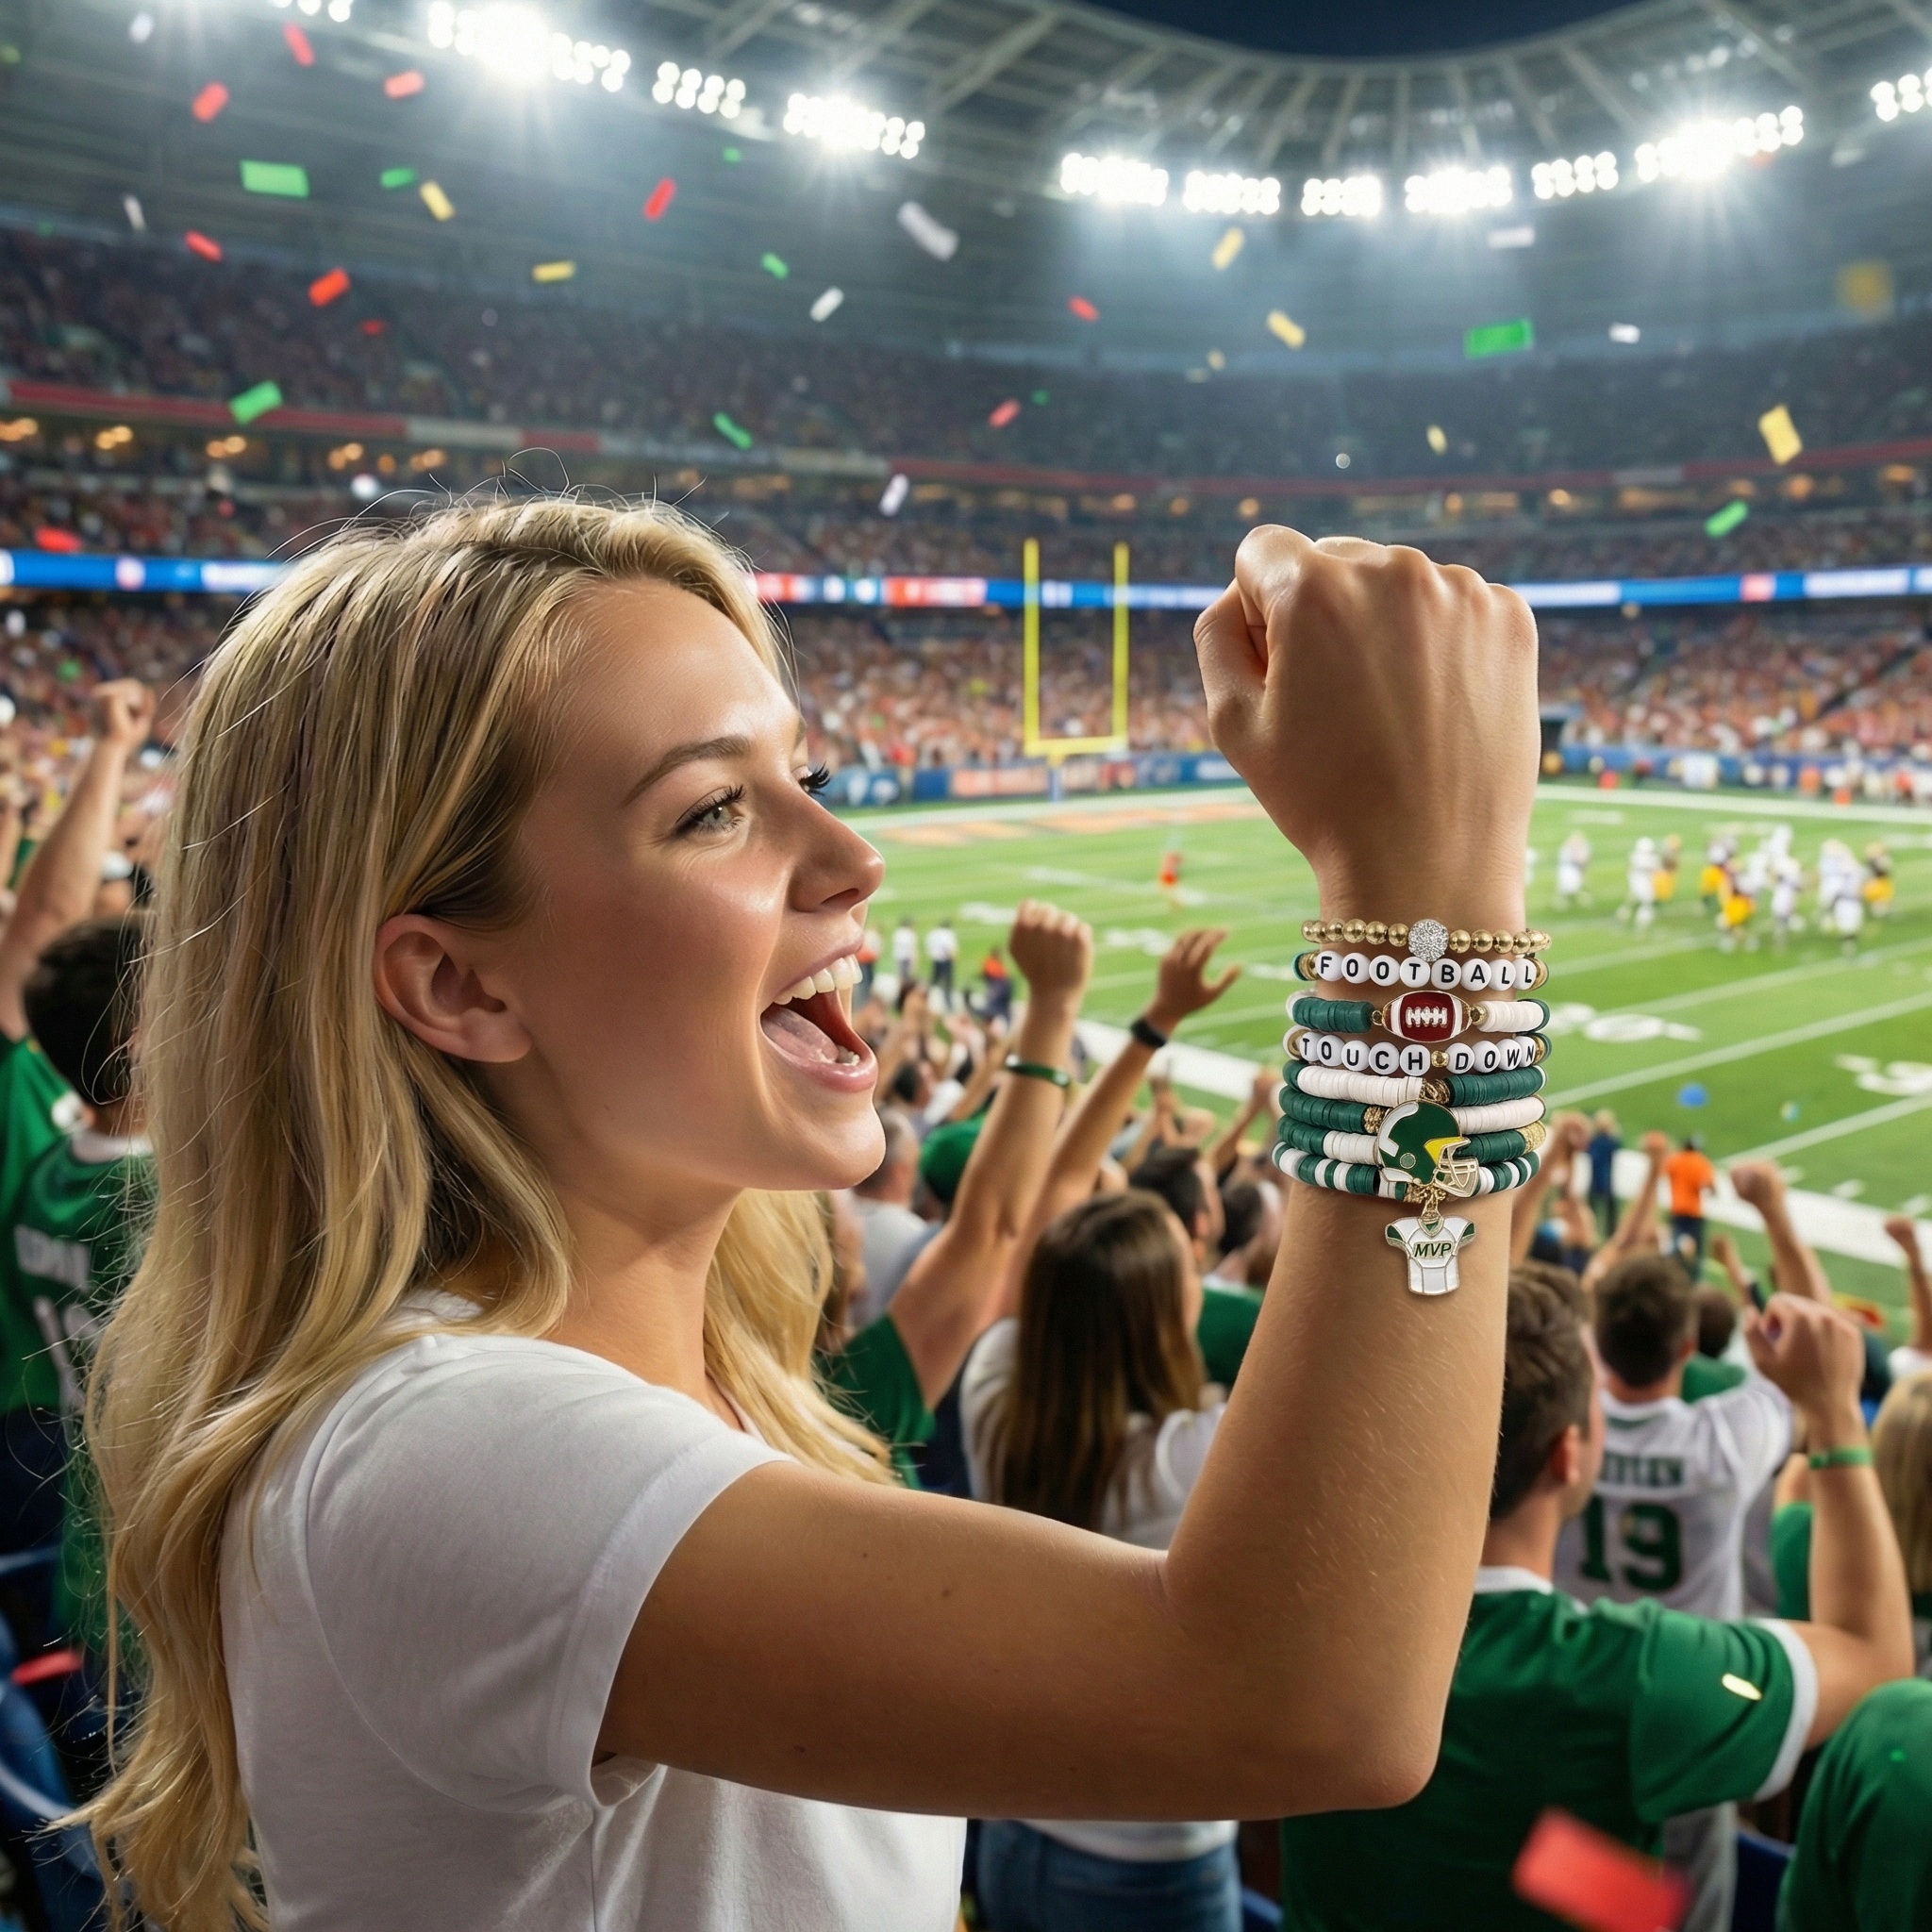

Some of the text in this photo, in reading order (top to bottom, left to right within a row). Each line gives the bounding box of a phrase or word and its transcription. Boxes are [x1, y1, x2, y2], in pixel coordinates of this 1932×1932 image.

[1320, 956, 1533, 985] FOOTBALL
[1301, 1038, 1535, 1072] TOUCH DOWN
[1414, 1242, 1452, 1258] MVP
[1579, 1496, 1681, 1592] 19
